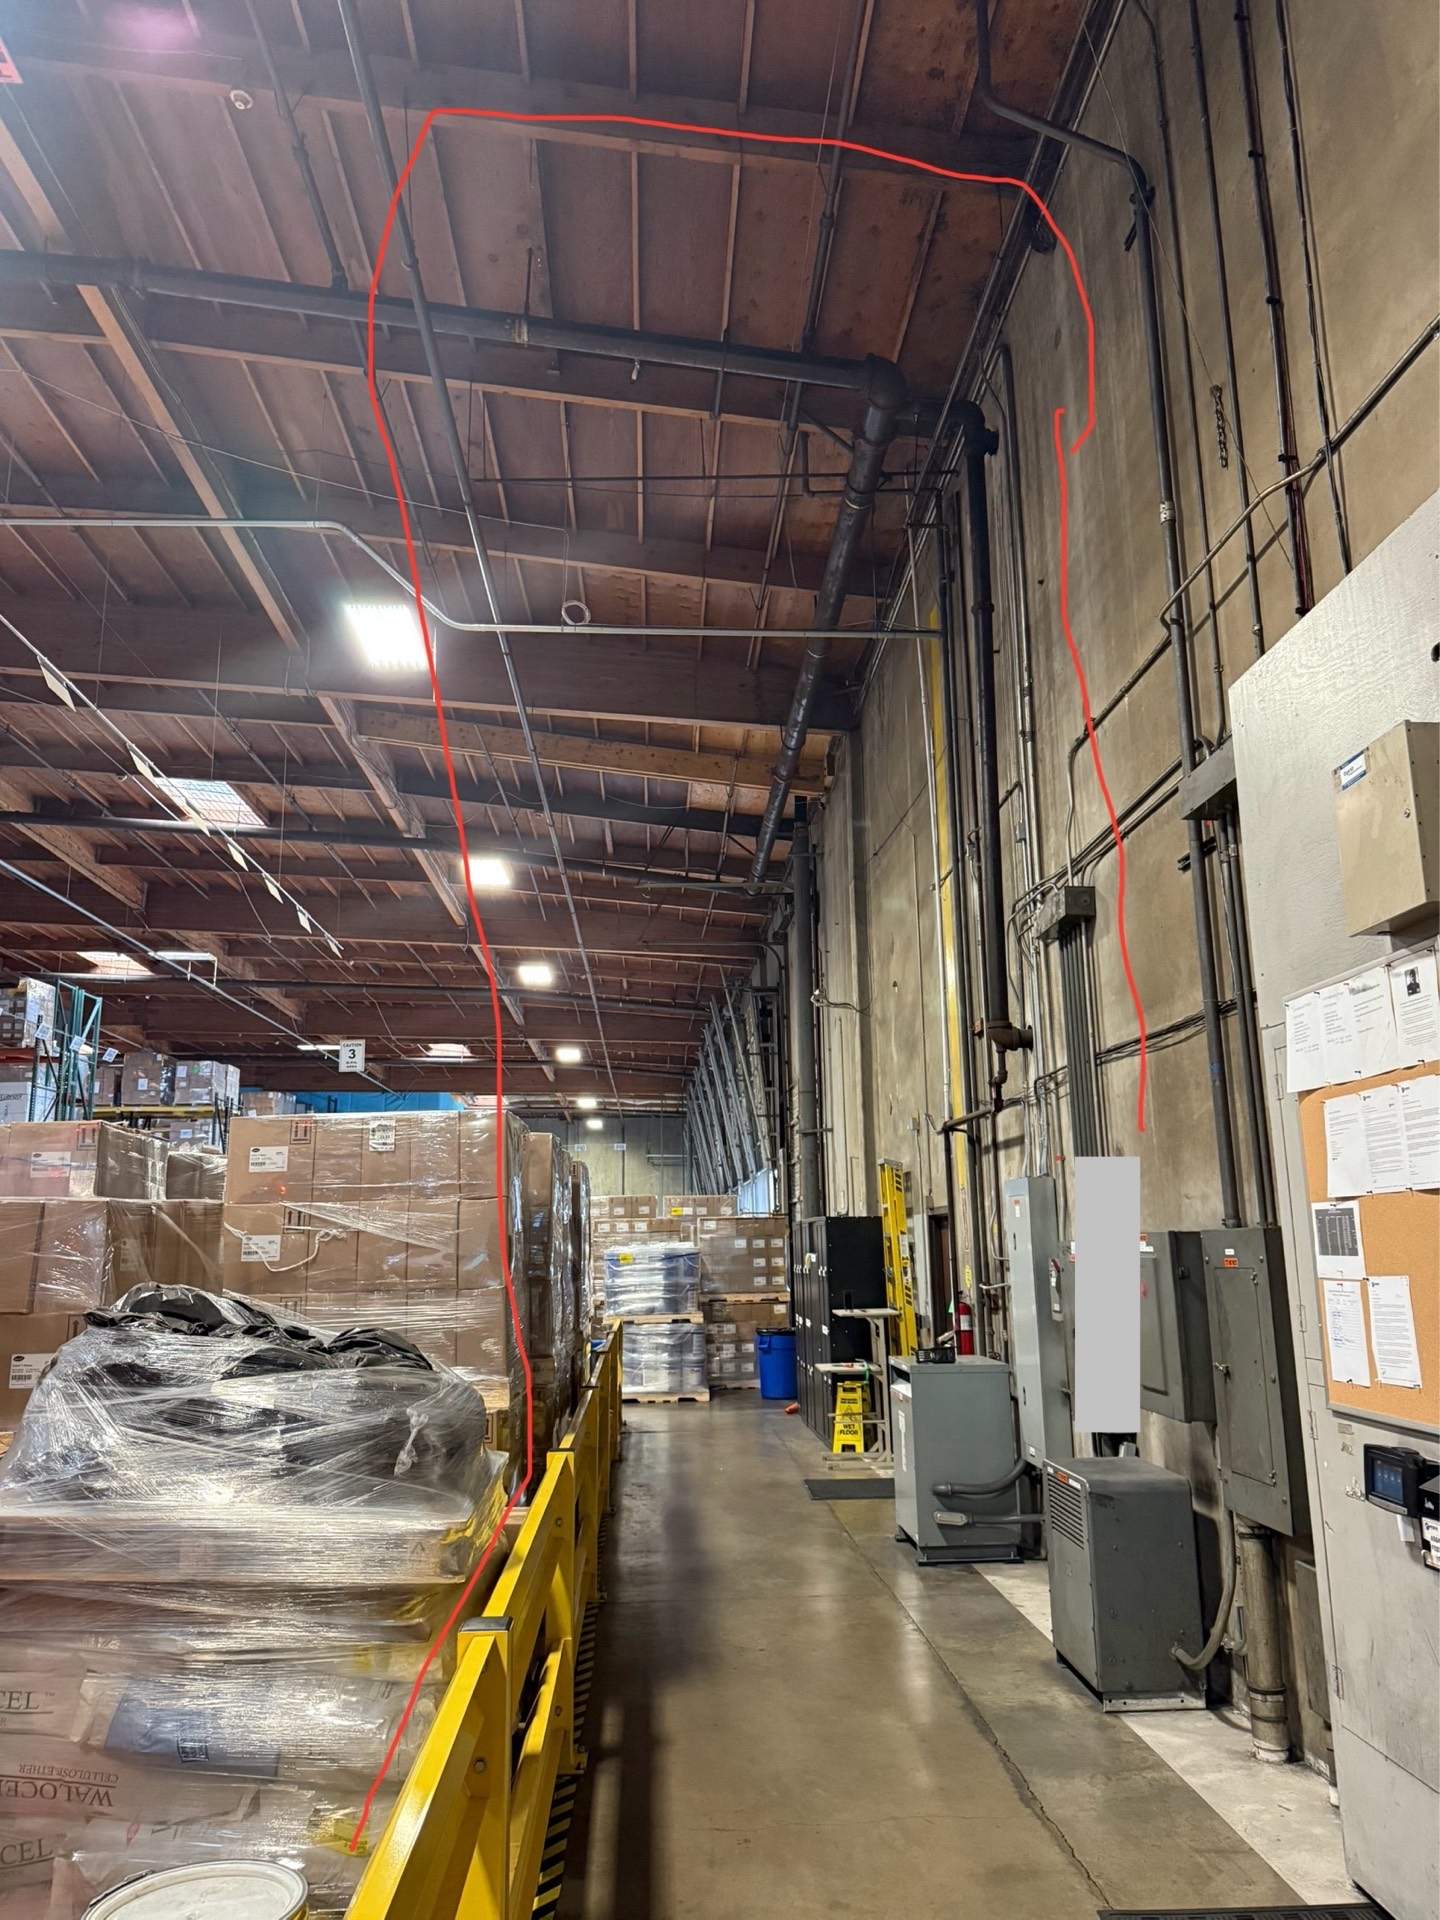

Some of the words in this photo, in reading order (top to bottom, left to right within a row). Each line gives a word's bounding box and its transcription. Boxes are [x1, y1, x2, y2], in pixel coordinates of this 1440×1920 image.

[348, 1049, 356, 1059] 3
[19, 1763, 54, 1777] ETHER
[56, 1768, 119, 1784] CELLULOSE
[0, 1780, 113, 1807] WALOCE
